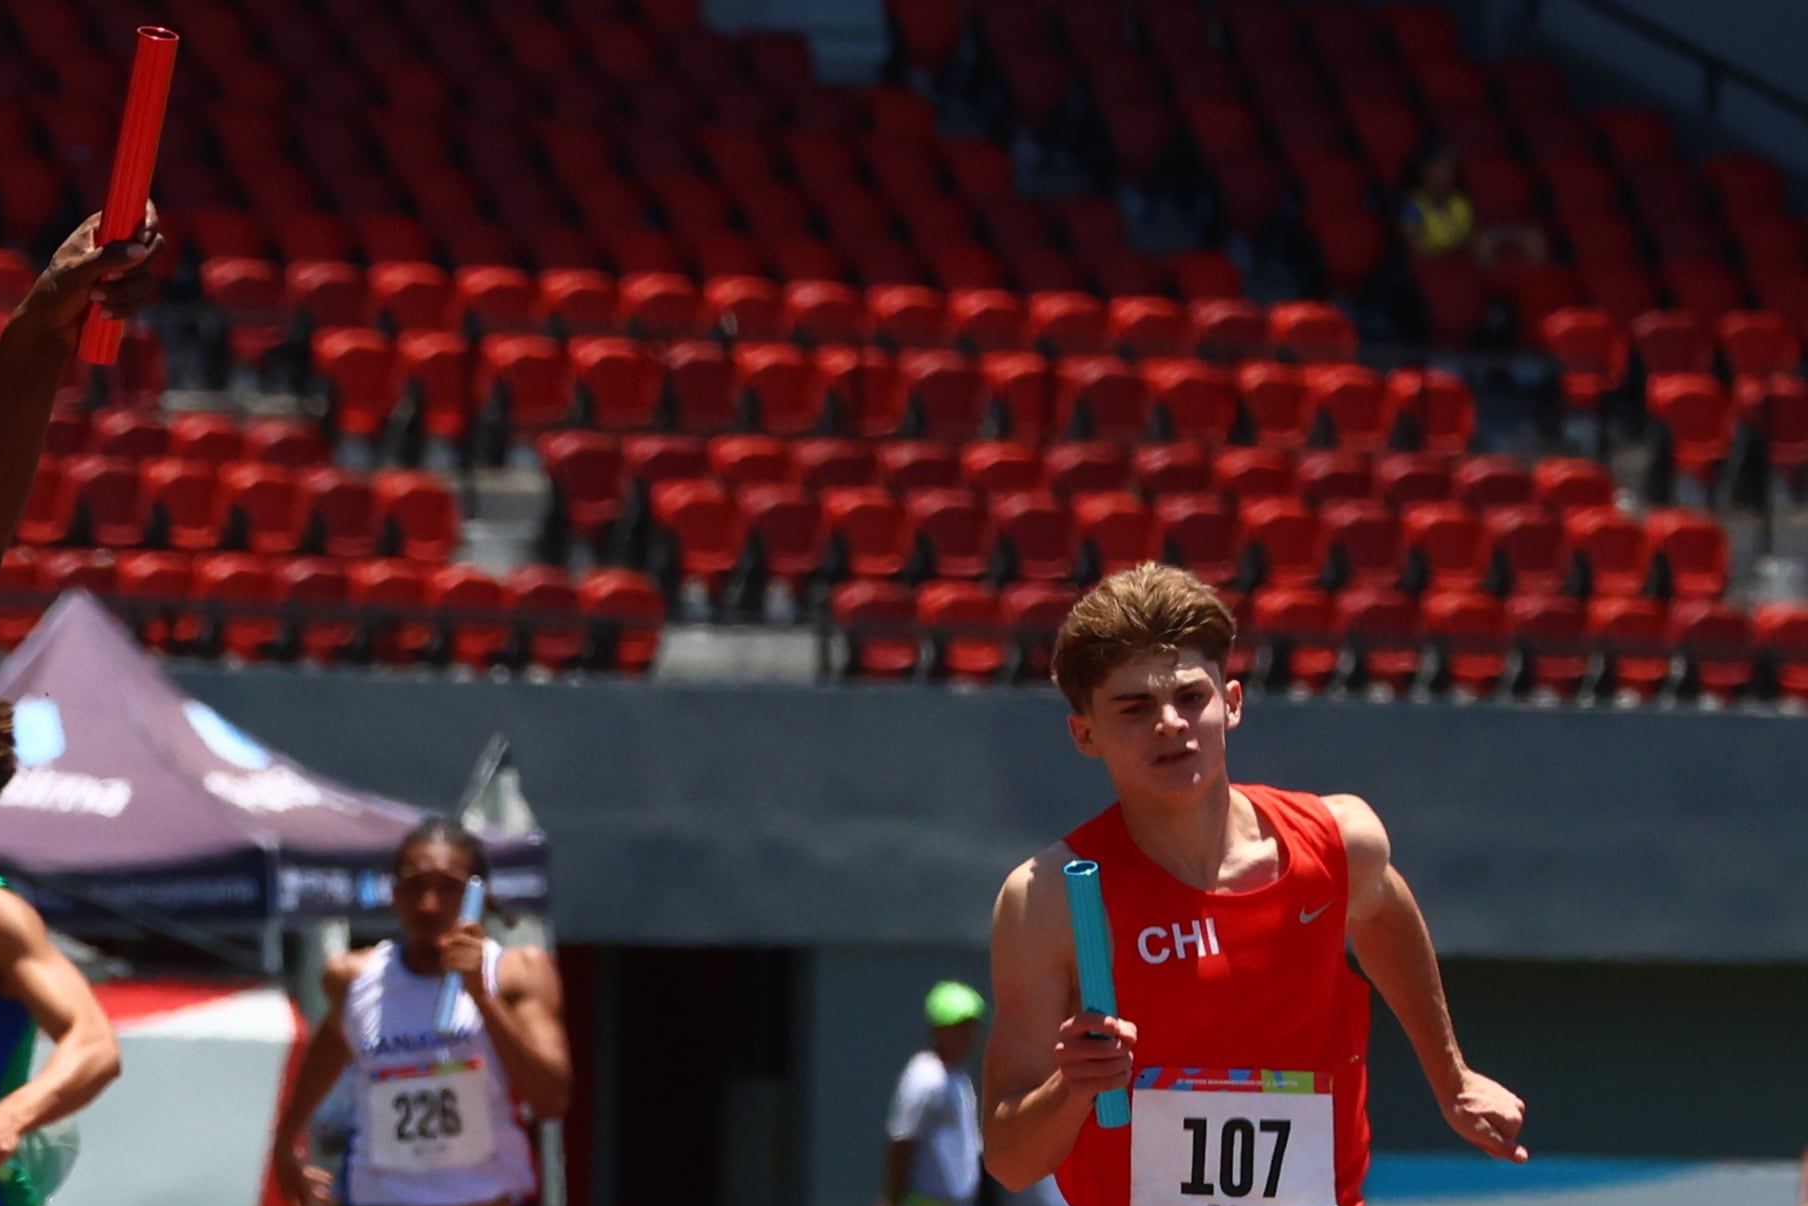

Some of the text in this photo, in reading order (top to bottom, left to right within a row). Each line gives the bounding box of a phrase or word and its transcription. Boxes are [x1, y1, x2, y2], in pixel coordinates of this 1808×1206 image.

[1137, 917, 1220, 965] CHI
[393, 1087, 463, 1142] 226
[1180, 1117, 1291, 1198] 107
